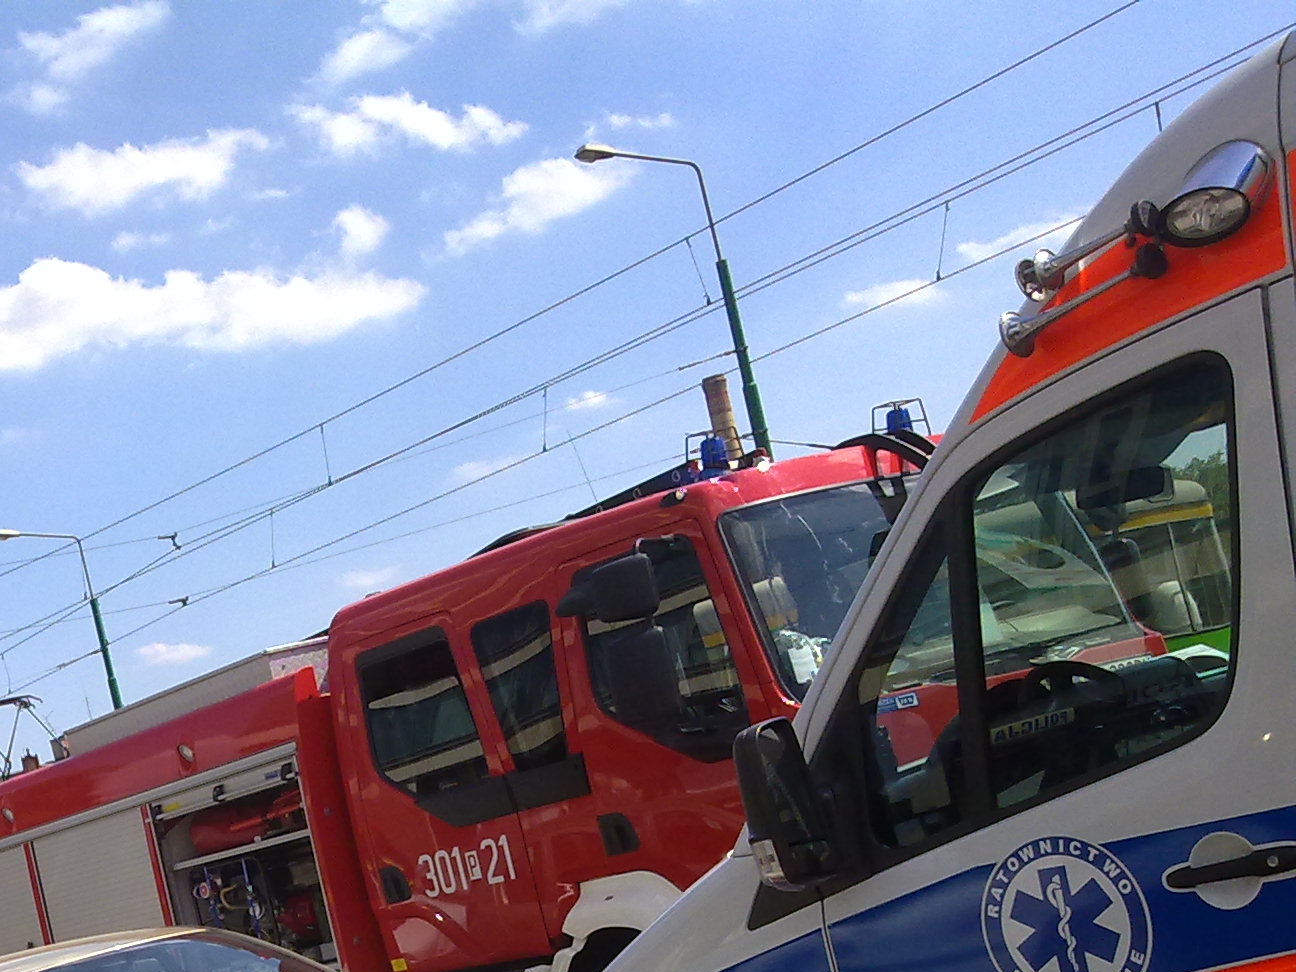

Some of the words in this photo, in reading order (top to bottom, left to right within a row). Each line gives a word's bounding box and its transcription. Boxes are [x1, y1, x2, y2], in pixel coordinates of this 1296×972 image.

[417, 846, 469, 898] 301
[479, 834, 517, 885] 21
[987, 839, 1133, 918] RATOWNICTWO
